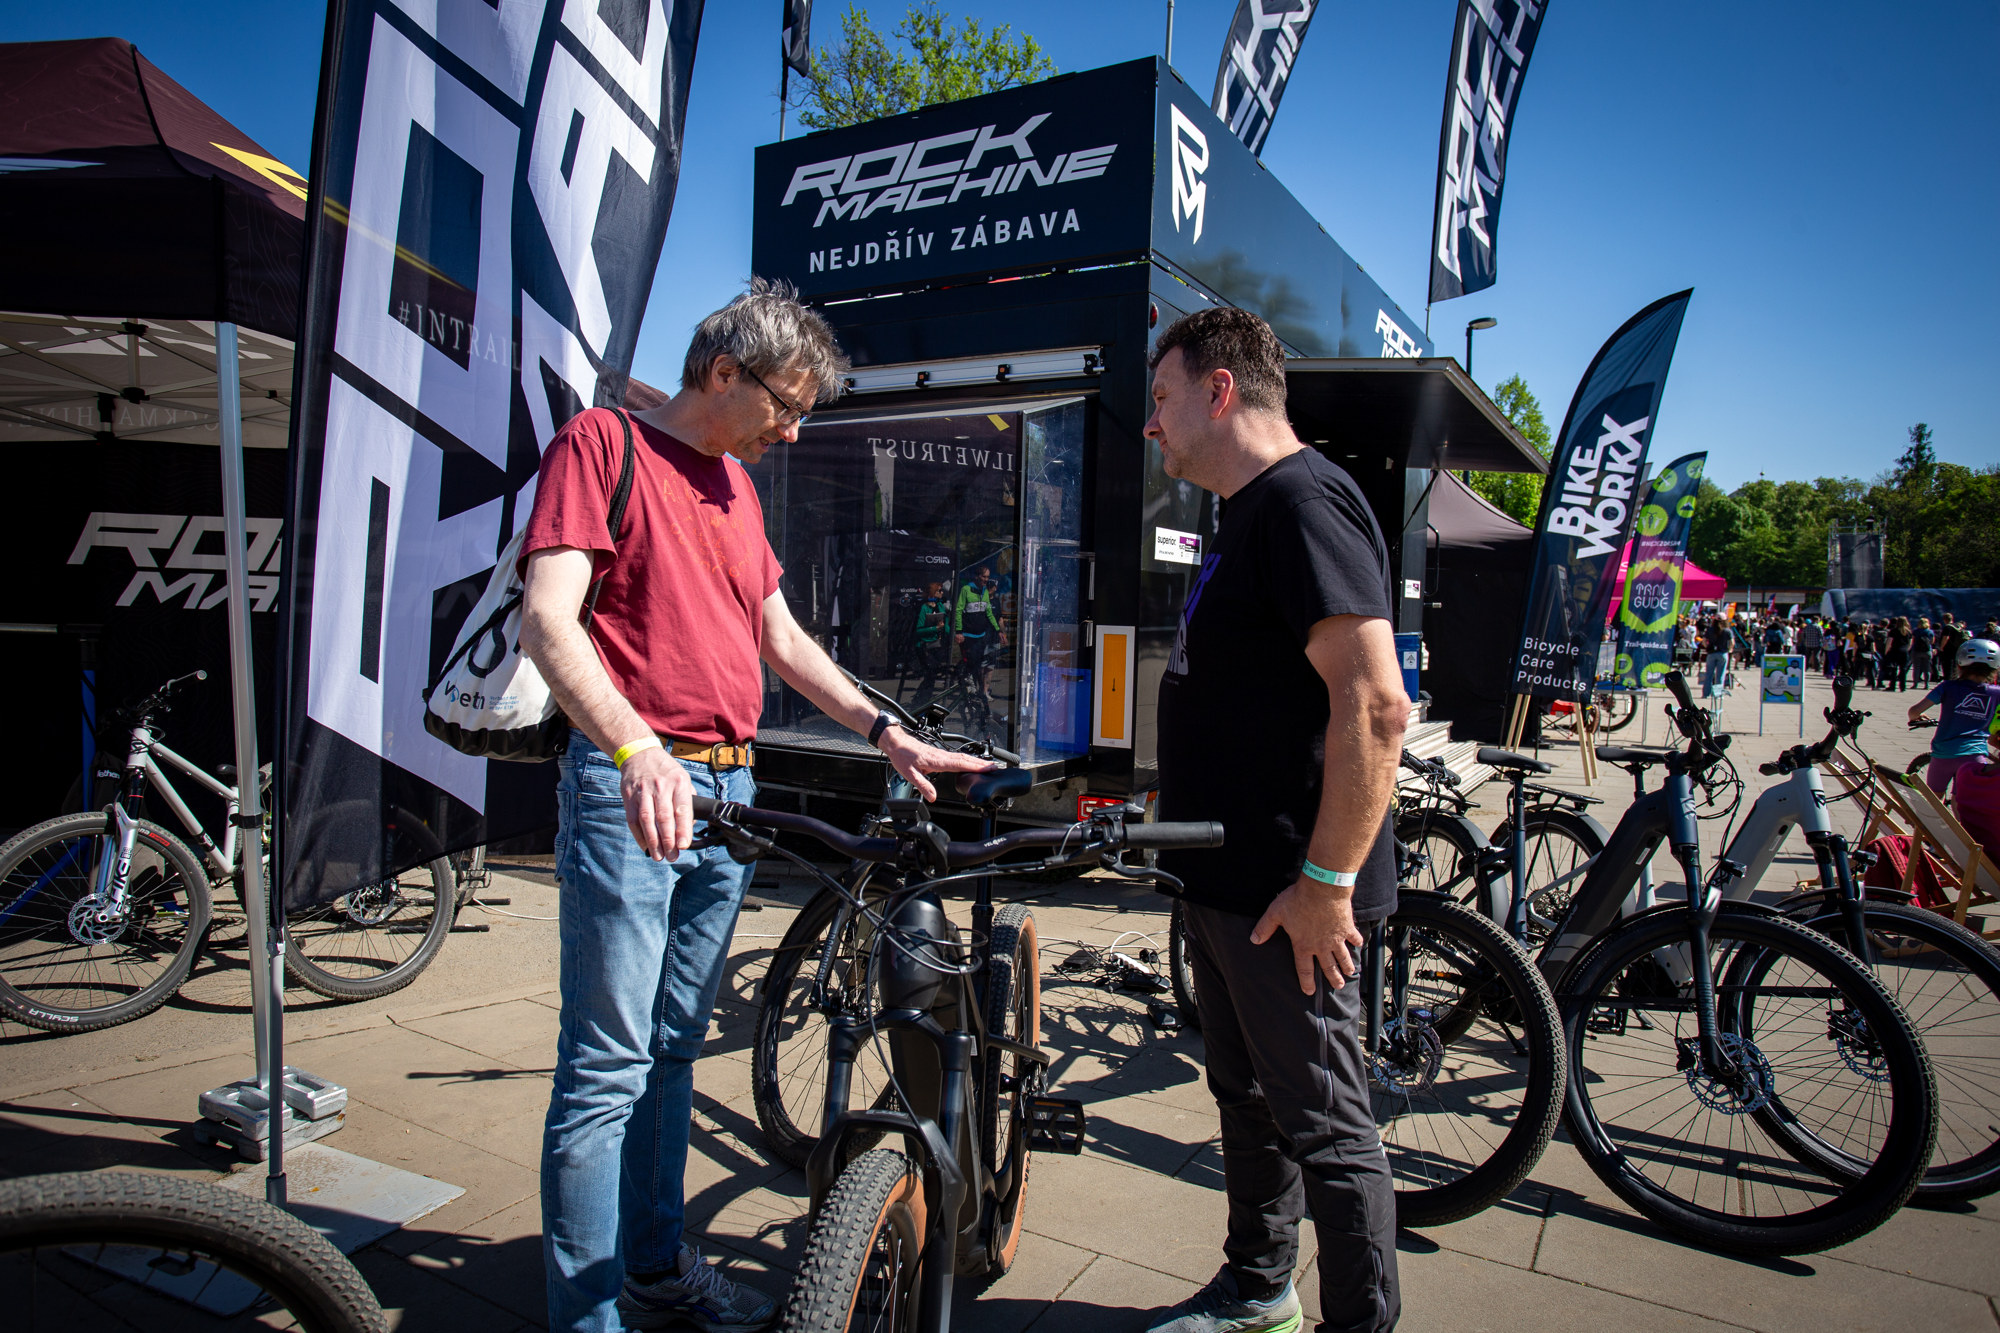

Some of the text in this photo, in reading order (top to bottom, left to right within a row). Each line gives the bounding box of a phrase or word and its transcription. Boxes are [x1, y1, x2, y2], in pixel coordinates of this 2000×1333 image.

[781, 112, 1053, 206] ROCK
[812, 144, 1119, 228] MACHINE
[809, 207, 1081, 273] NEJDŘÍV ZÁBAVA
[1547, 446, 1598, 537] BIKE
[1576, 413, 1649, 559] WORKX
[115, 570, 279, 613] MA
[1520, 654, 1555, 669] Care
[1524, 637, 1580, 656] Bicycle
[1516, 670, 1587, 691] Products
[28, 1008, 80, 1022] SCYLLA
